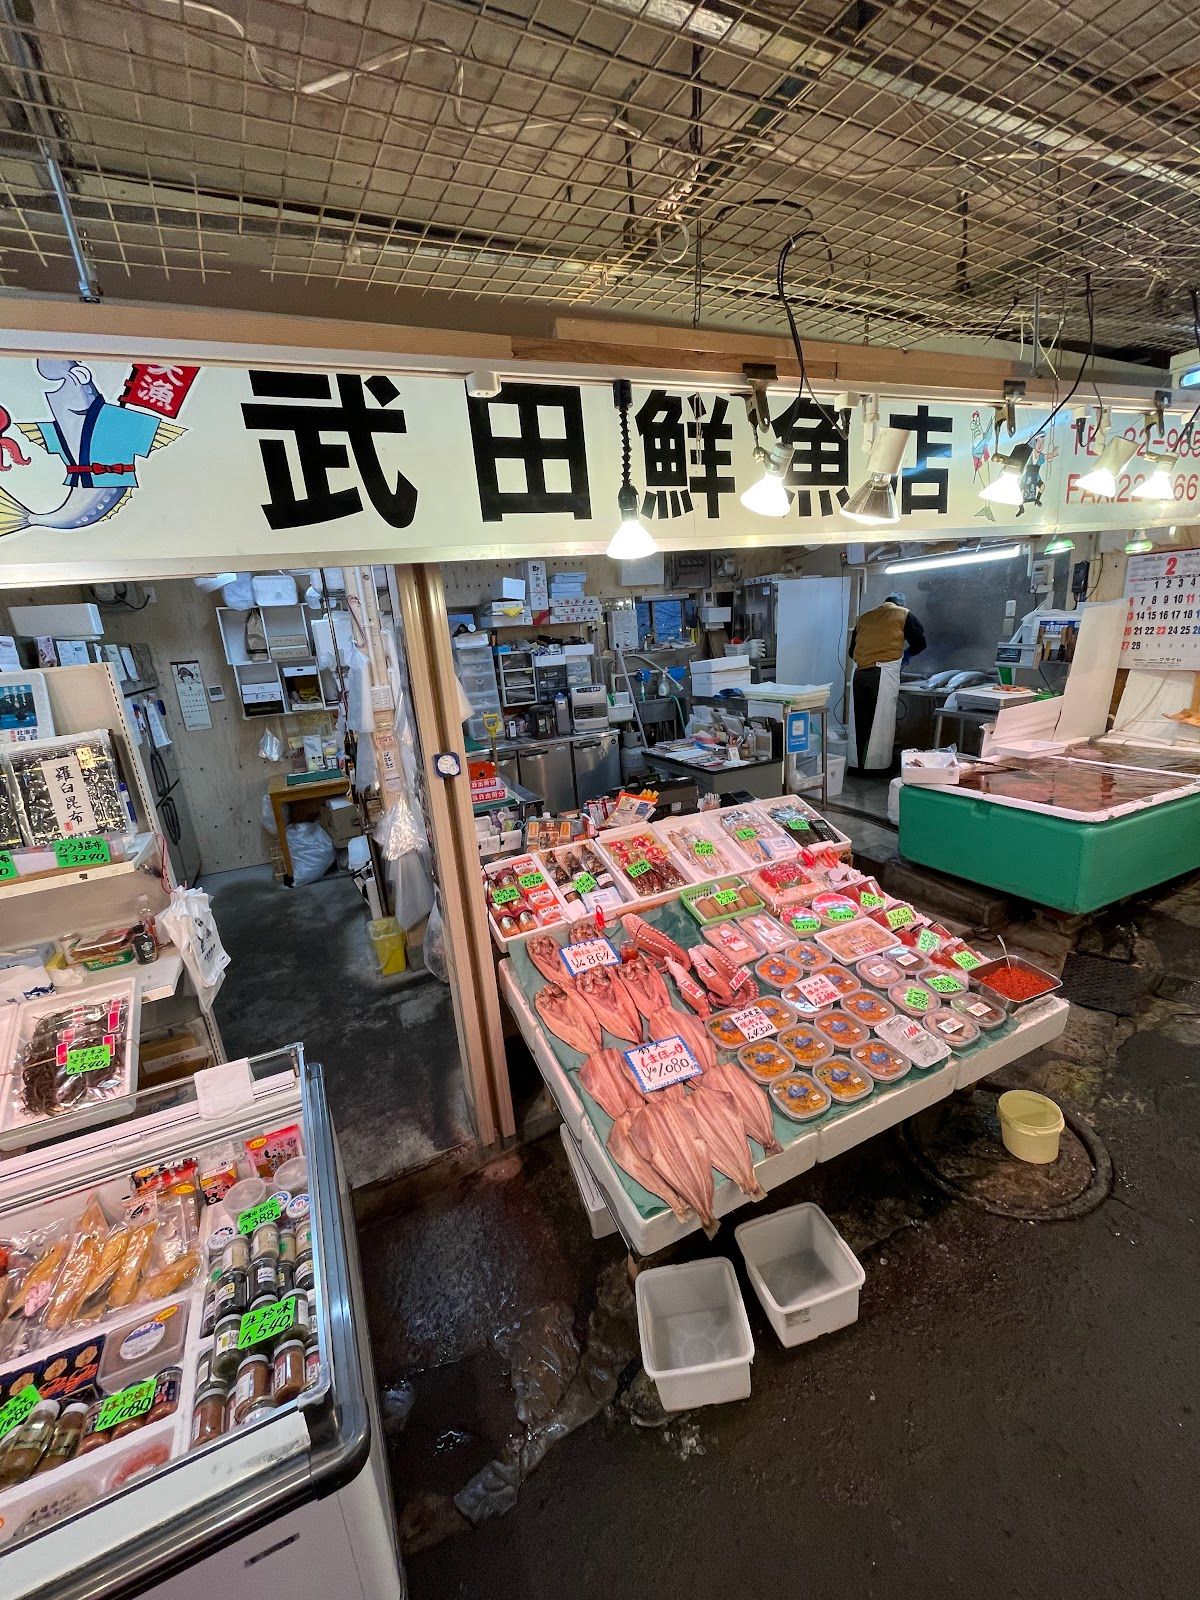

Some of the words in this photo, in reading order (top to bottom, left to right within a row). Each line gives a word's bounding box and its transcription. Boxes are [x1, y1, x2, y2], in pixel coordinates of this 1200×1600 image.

[240, 369, 954, 530] 武田鮮魚店
[1165, 557, 1177, 575] 2
[1166, 580, 1172, 588] 2
[1178, 579, 1184, 587] 3
[1190, 578, 1196, 586] 4
[1140, 597, 1145, 605] 7
[1152, 596, 1157, 604] 8
[1164, 595, 1169, 604] 9
[1174, 595, 1183, 604] 10
[1186, 594, 1195, 603] 11
[1136, 612, 1145, 620] 14
[1148, 611, 1156, 620] 15
[1160, 611, 1168, 619] 16
[1172, 610, 1180, 619] 17
[1184, 610, 1192, 618] 18
[1156, 626, 1166, 636] 23
[1168, 626, 1177, 634] 24
[1180, 626, 1190, 634] 25
[55, 765, 84, 826] 羅臼昆布
[244, 1302, 292, 1329] 生珍味
